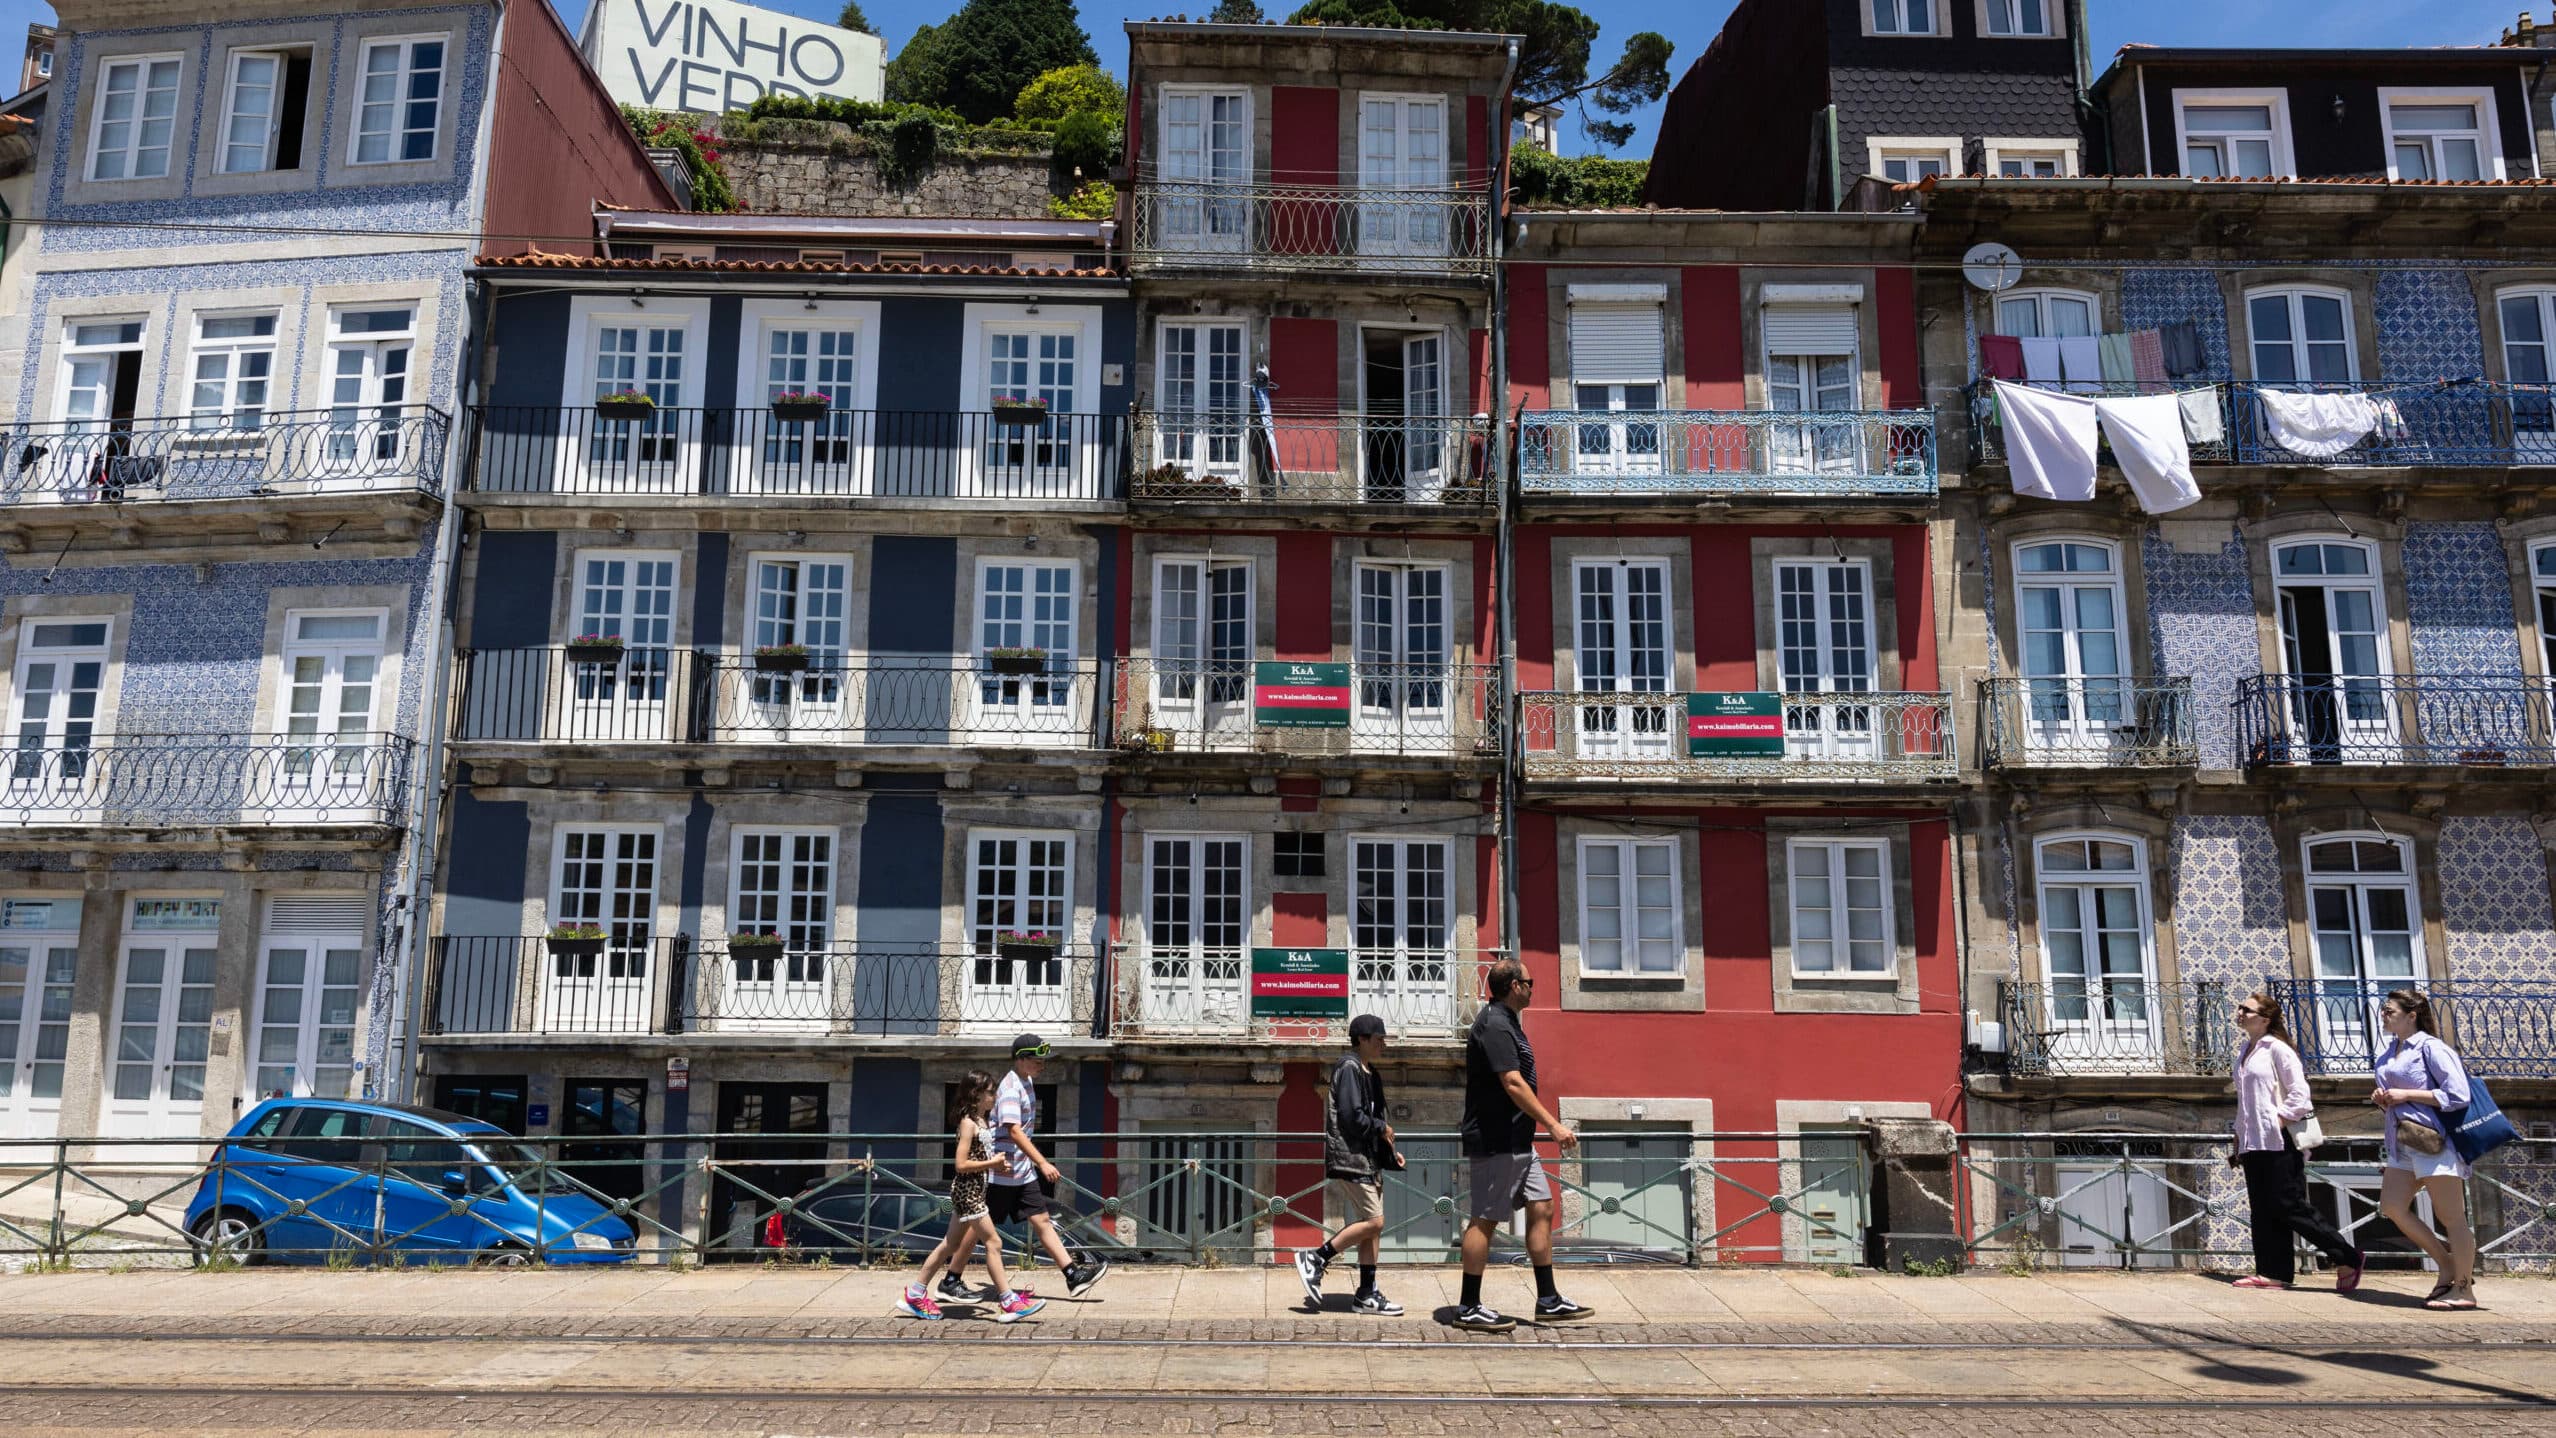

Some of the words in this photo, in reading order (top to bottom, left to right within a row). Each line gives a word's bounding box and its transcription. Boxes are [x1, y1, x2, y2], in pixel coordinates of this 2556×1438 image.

[634, 0, 845, 87] VINHO
[627, 47, 858, 114] VER
[1291, 665, 1314, 675] K&A
[1722, 695, 1746, 705] K&A
[1287, 951, 1312, 962] K&A
[1260, 981, 1340, 989] www.kaimobiliaria.com
